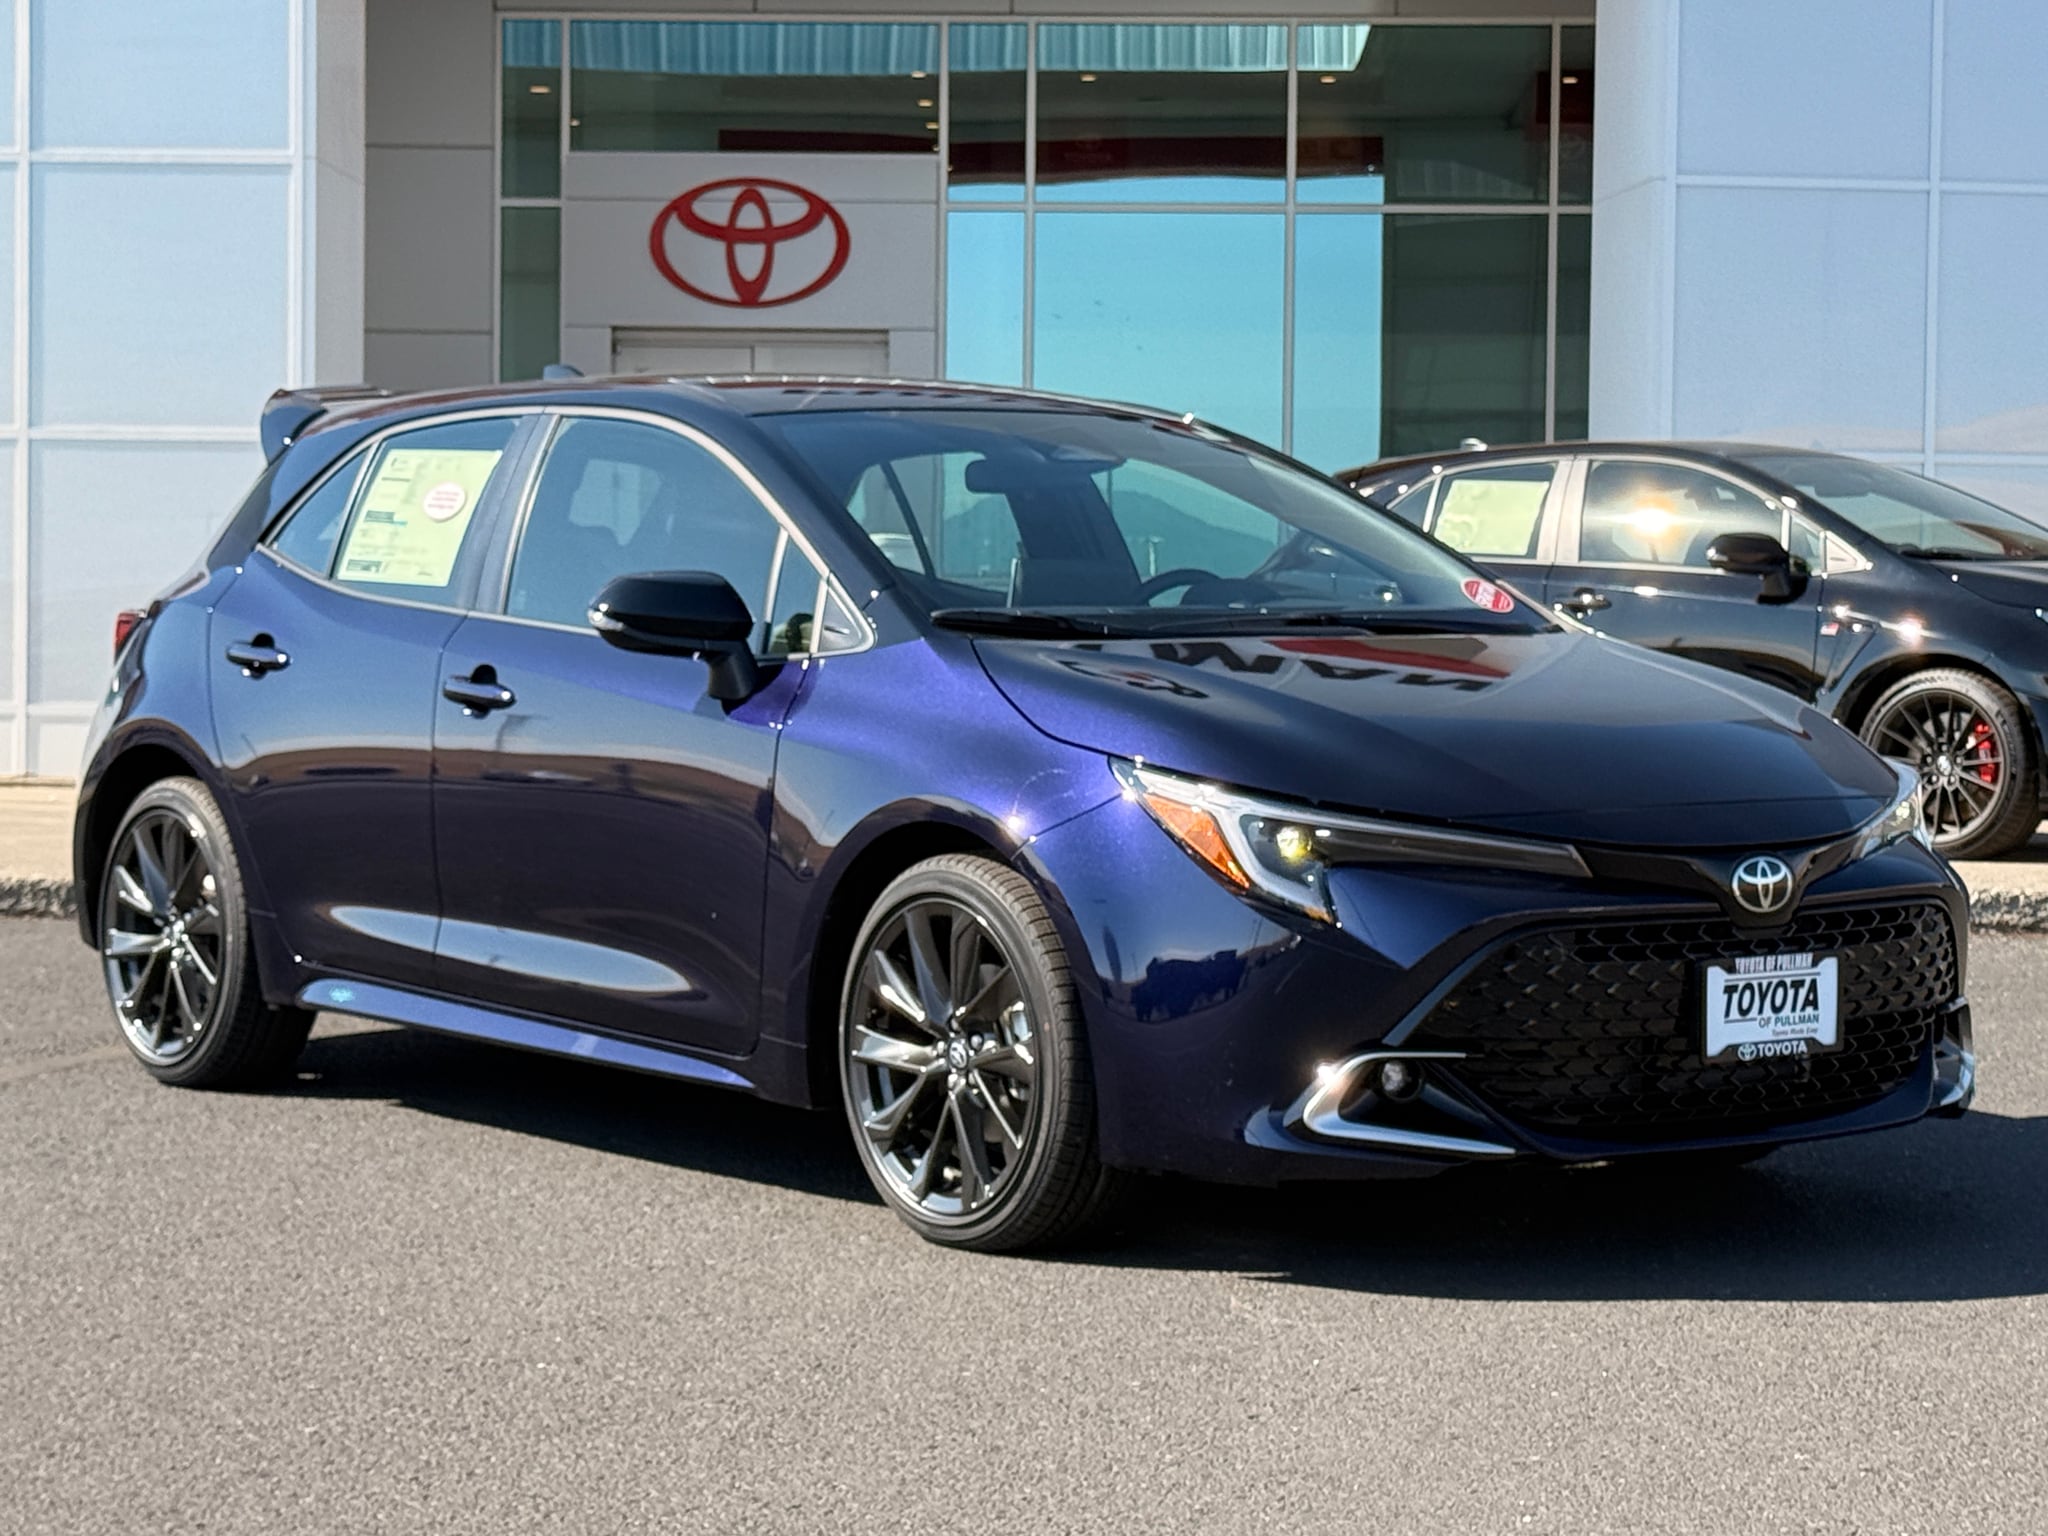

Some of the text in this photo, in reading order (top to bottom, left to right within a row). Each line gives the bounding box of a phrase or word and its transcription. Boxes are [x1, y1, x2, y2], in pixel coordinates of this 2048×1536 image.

[1723, 978, 1819, 1019] TOYOTA
[1758, 1013, 1820, 1028] OF PULLMAN
[1757, 1040, 1808, 1057] TOYOTA
